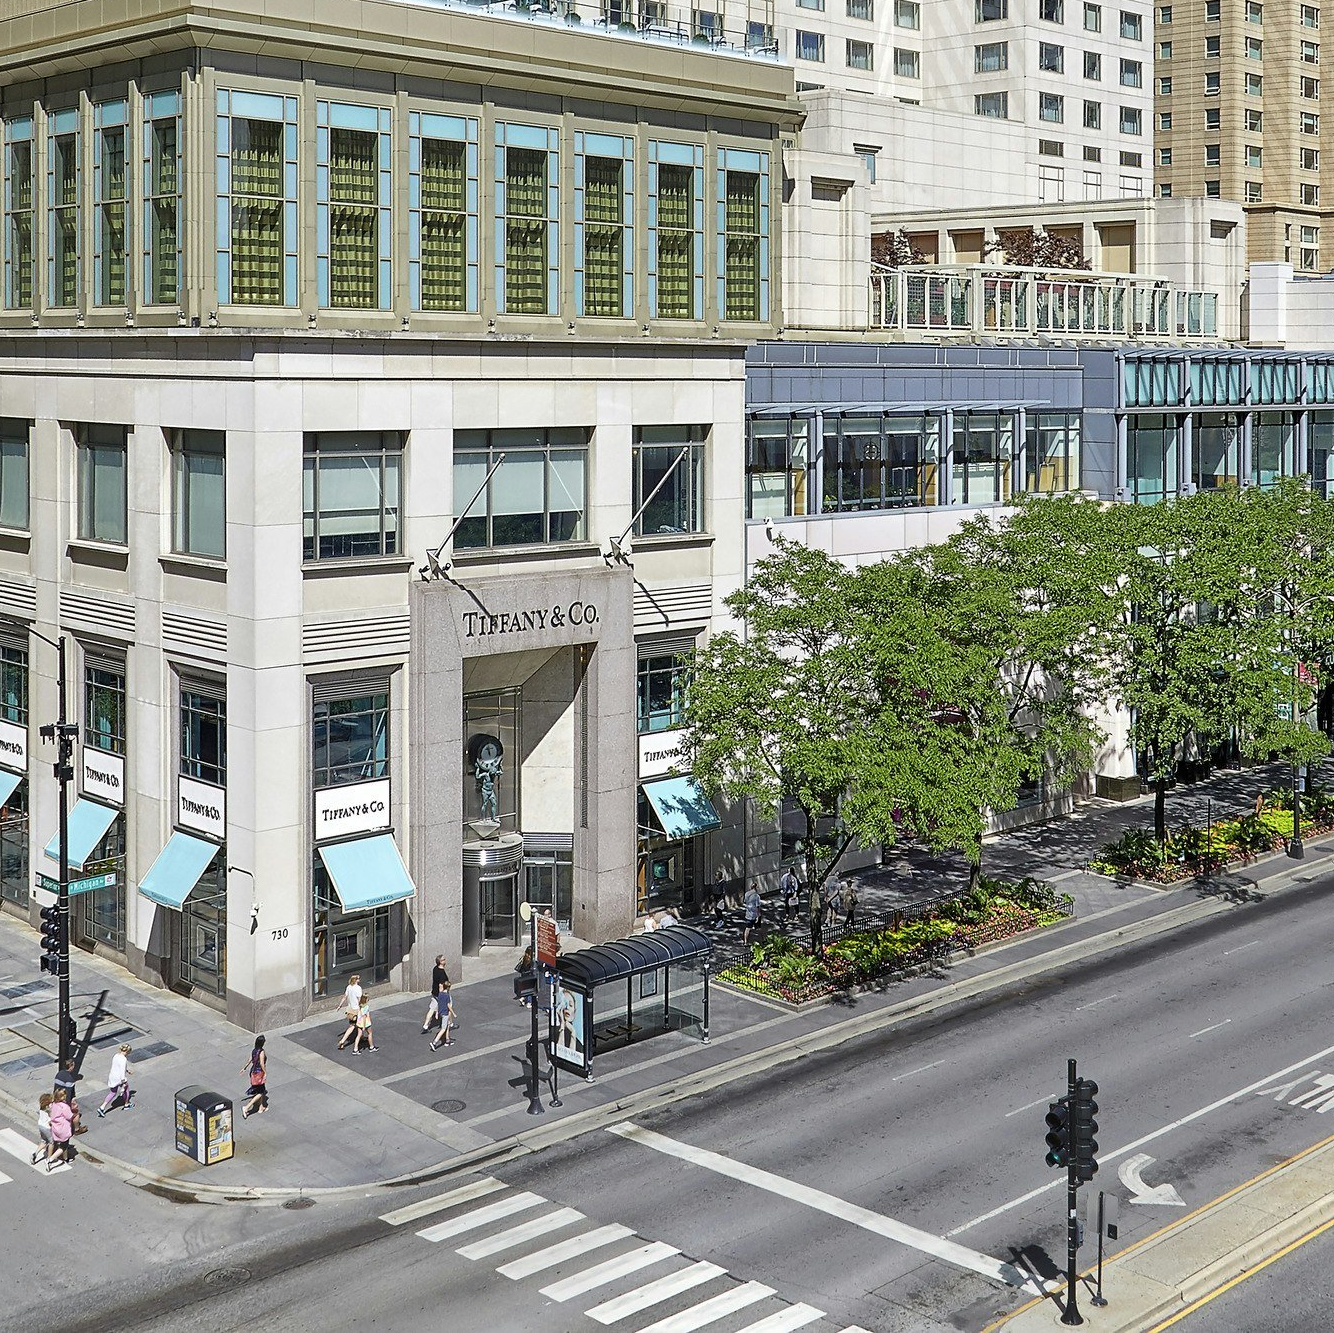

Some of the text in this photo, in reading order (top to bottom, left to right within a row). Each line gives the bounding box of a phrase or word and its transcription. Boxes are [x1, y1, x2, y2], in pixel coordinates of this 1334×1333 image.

[463, 609, 549, 637] TIFFANY
[551, 605, 566, 628] &
[181, 797, 204, 816] TIFFANY
[322, 805, 361, 821] TIFFANY
[362, 803, 369, 815] &
[272, 928, 288, 941] 730
